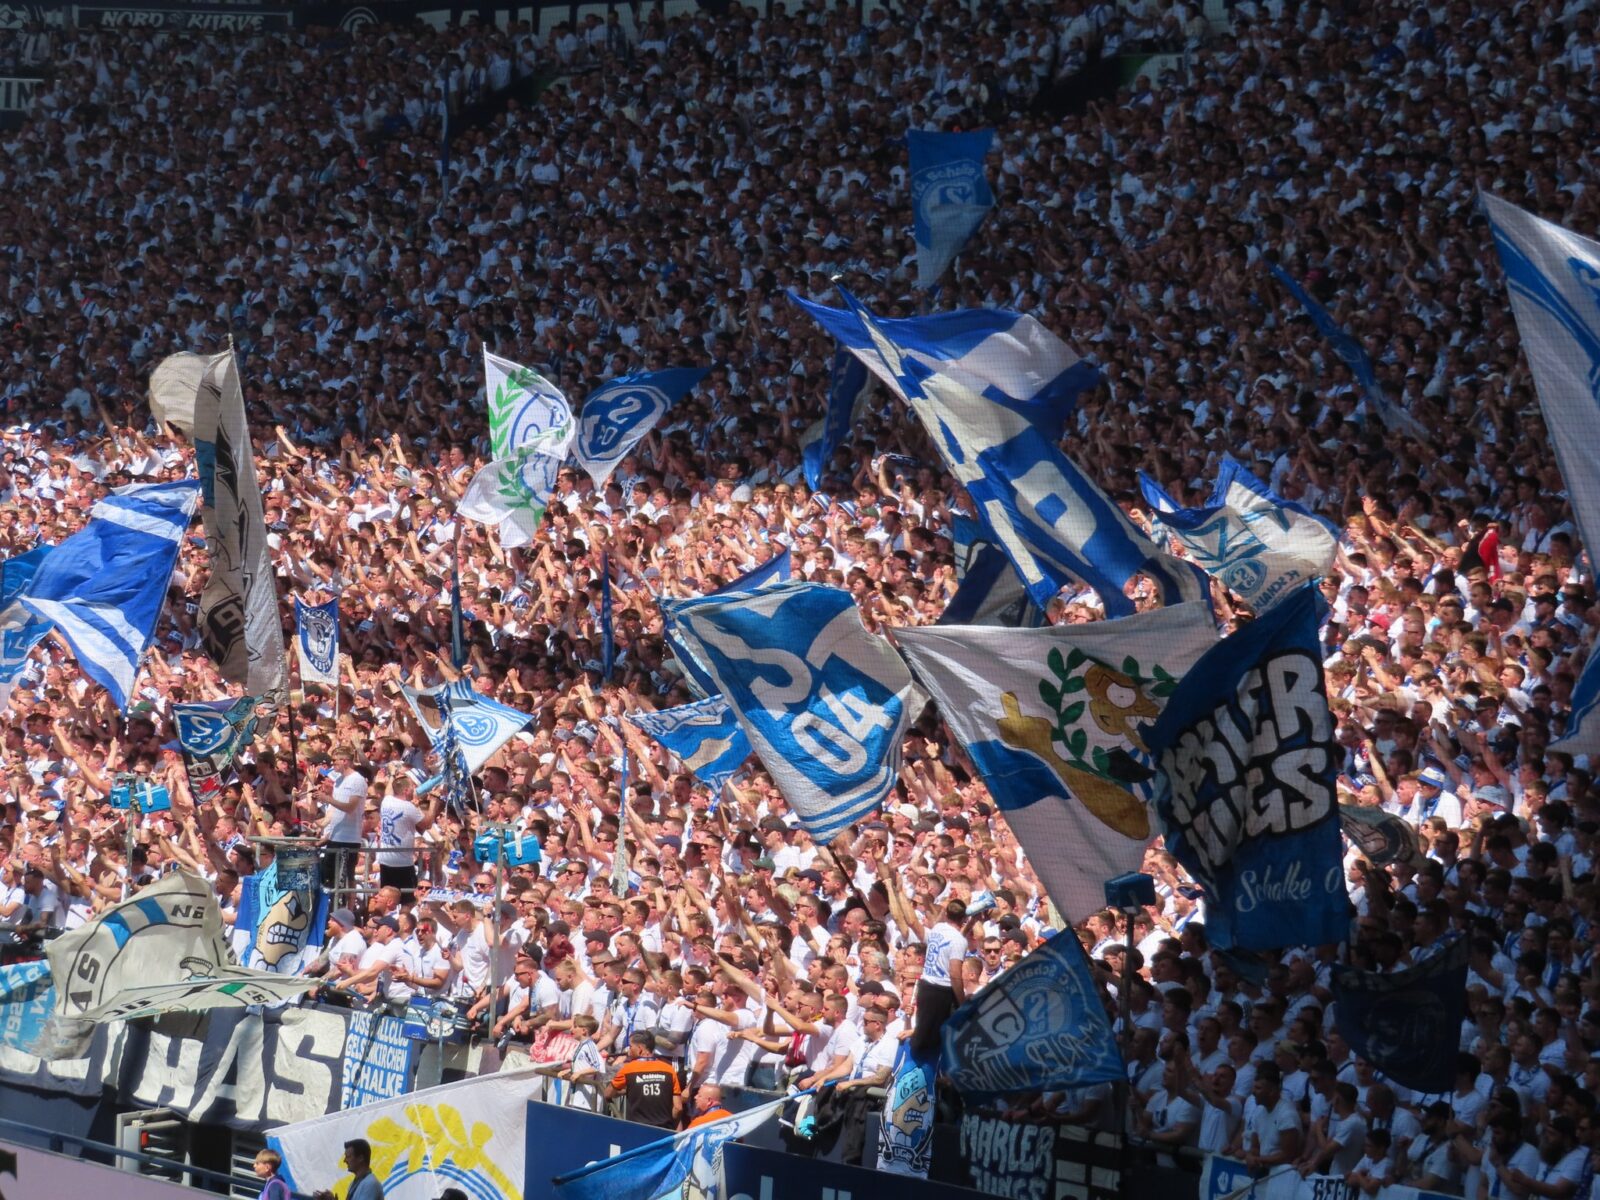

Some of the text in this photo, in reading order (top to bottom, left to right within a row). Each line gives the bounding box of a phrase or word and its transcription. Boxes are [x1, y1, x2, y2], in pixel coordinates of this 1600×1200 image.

[101, 11, 164, 28] NORD
[1235, 864, 1312, 912] Schalke
[345, 1033, 408, 1072] GELSNKIRCHEN
[342, 1058, 404, 1097] SCHALKE
[643, 1084, 661, 1096] 613
[959, 1113, 1056, 1181] MARLER
